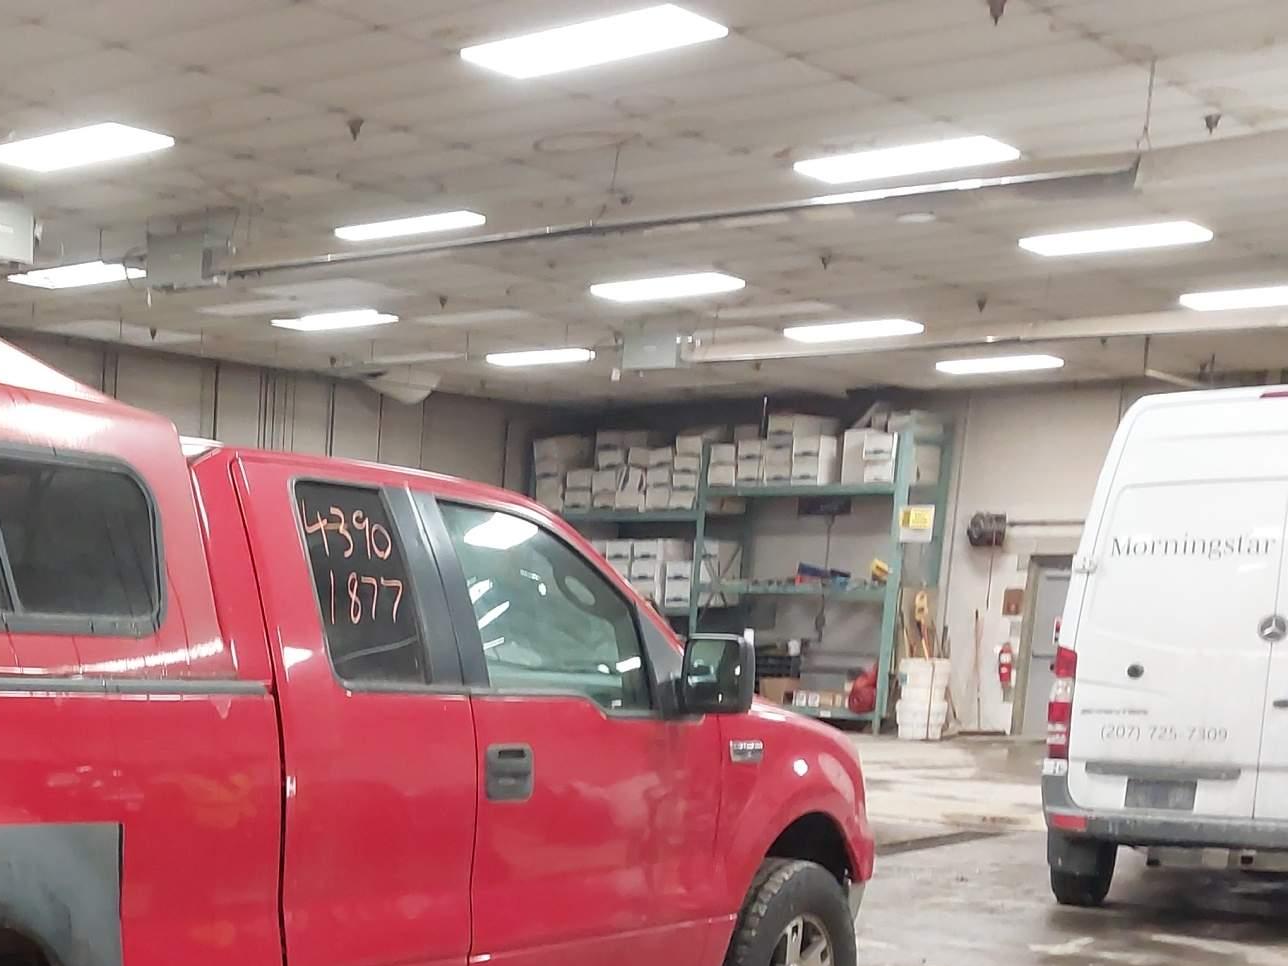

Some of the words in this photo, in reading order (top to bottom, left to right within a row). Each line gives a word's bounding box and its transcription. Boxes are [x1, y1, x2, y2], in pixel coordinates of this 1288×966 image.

[300, 498, 392, 560] 4390
[1111, 531, 1277, 560] Morningstar
[329, 569, 404, 625] 1877
[1100, 725, 1142, 742] (207)
